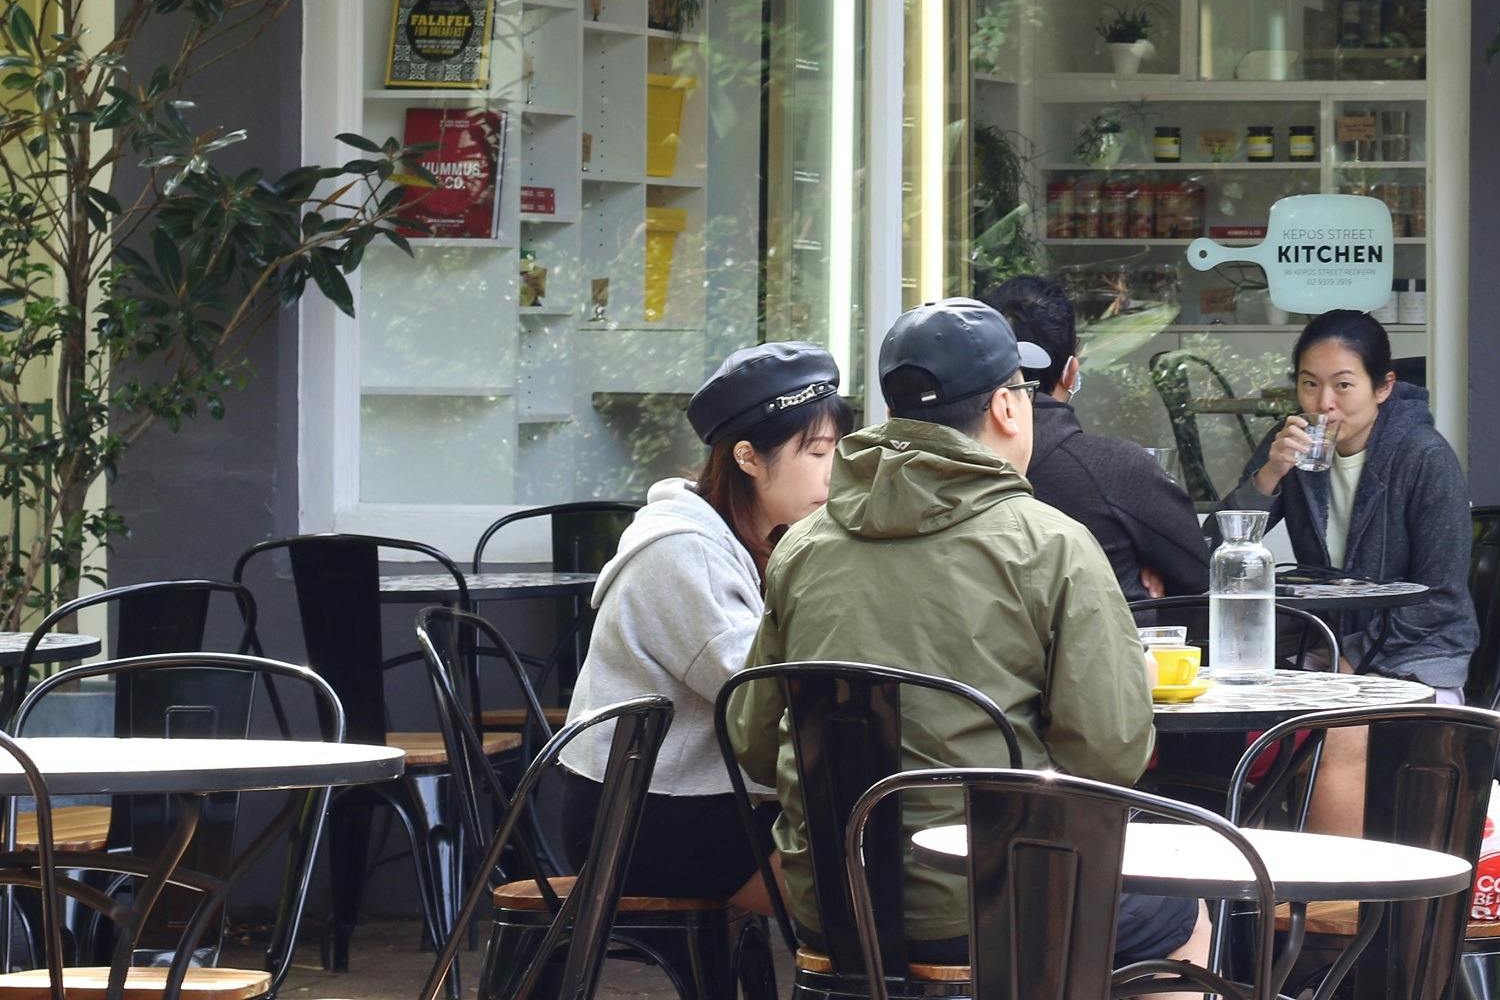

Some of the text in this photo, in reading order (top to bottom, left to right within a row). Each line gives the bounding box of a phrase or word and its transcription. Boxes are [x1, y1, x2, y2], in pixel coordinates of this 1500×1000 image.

[411, 14, 472, 27] FALAFEL
[1283, 229, 1375, 240] KEPOS STREET
[1278, 245, 1383, 263] KITCHEN
